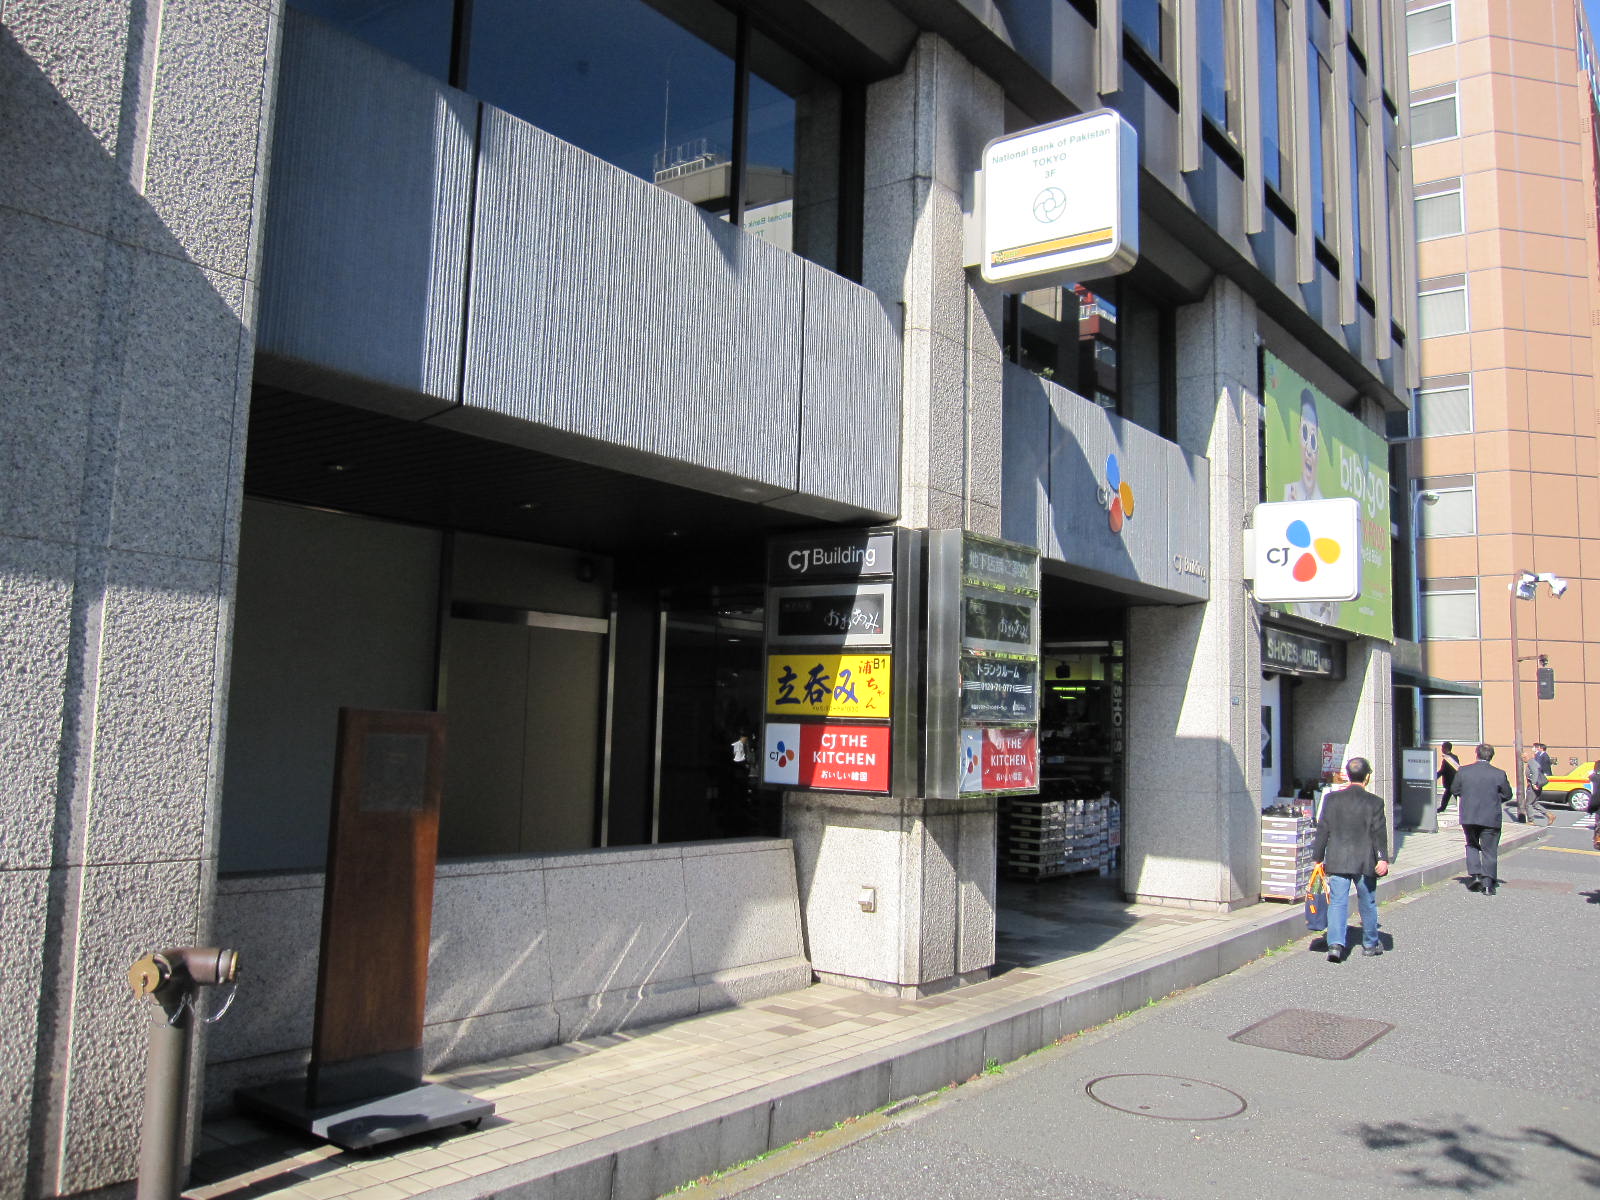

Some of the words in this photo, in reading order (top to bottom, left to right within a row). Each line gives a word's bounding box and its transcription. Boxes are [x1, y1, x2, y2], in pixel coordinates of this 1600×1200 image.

[992, 147, 1029, 165] National
[1032, 143, 1054, 155] Bank
[1057, 138, 1067, 148] of
[1069, 127, 1111, 145] Pakistan
[1033, 152, 1067, 169] TOKYO
[1044, 169, 1057, 180] 3F
[788, 549, 811, 573] CJ
[813, 546, 876, 567] Building
[1267, 547, 1290, 567] CJ
[977, 663, 1020, 679] トランクルーム
[775, 663, 859, 706] 立呑み
[821, 733, 838, 750] CJ
[839, 734, 868, 748] THE
[1007, 738, 1022, 749] THE
[769, 751, 780, 761] CJ
[813, 751, 876, 766] KITCHEN
[991, 754, 1026, 767] KITCHEN
